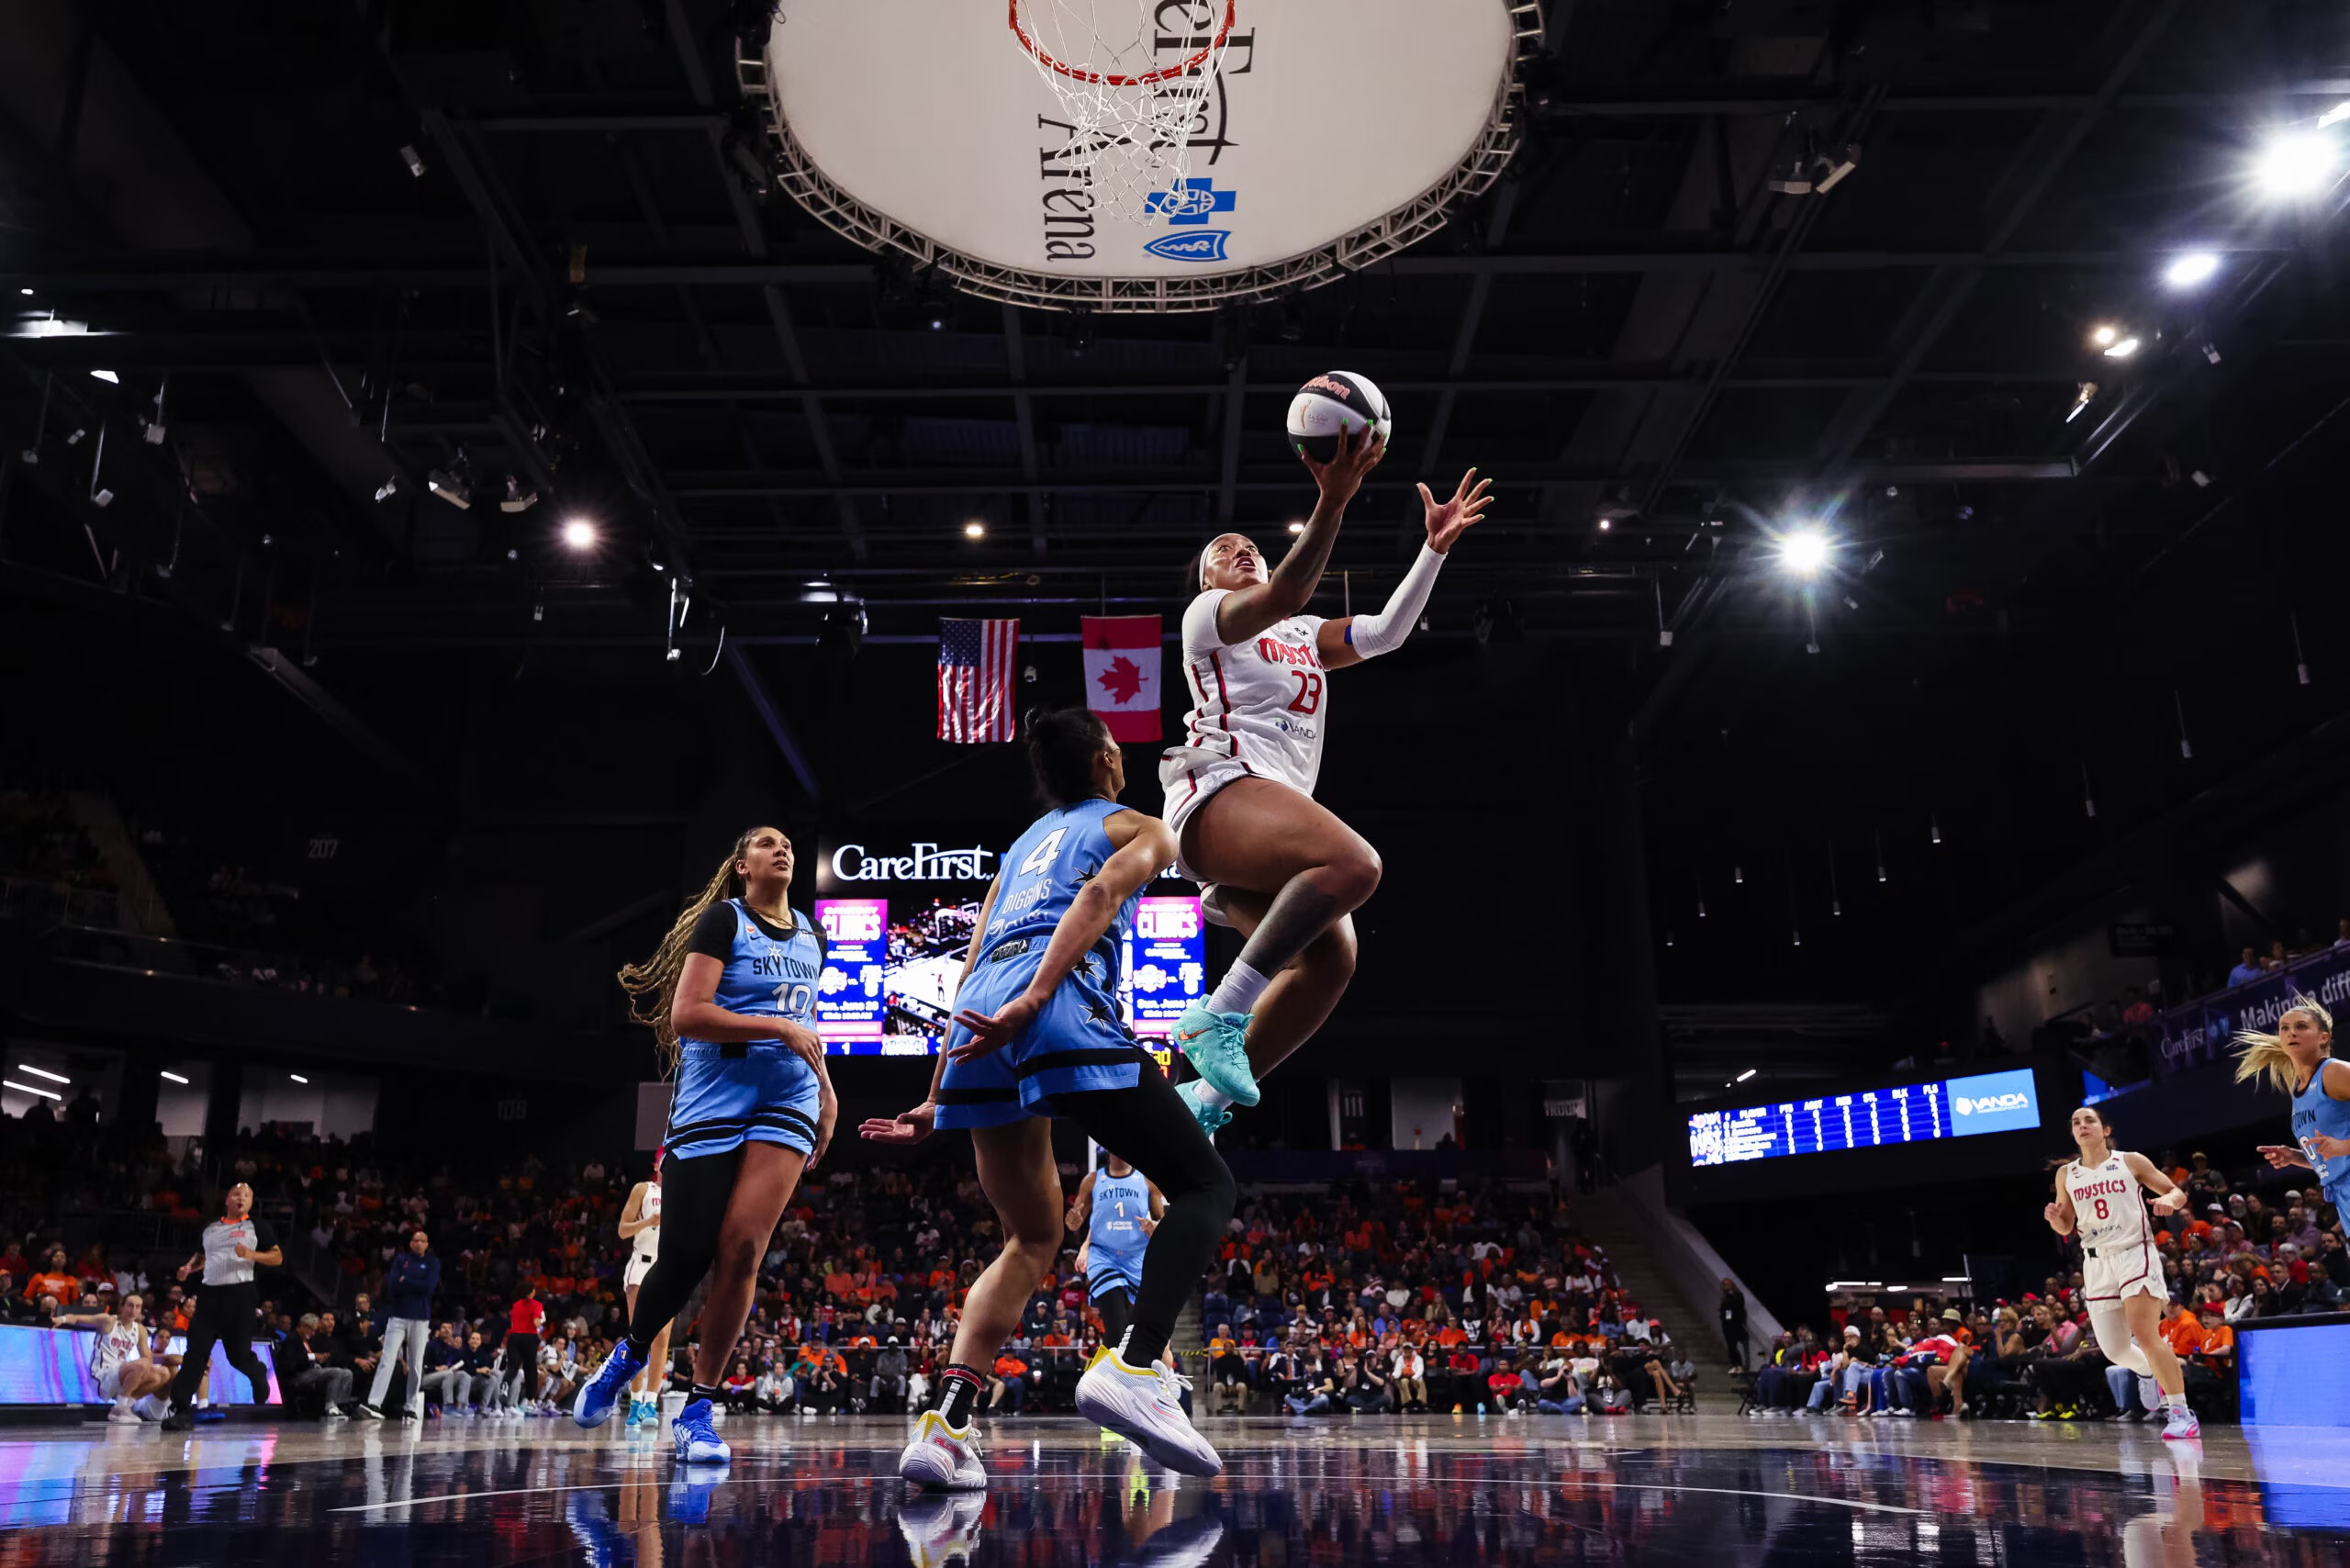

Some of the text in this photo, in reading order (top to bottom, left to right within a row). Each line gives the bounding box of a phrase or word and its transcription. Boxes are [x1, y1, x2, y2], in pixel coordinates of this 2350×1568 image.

[1038, 114, 1132, 263] Arena
[1288, 670, 1322, 714] 23
[308, 838, 338, 859] 207
[1018, 827, 1069, 877] 4
[1002, 878, 1053, 914] DIGGINS
[753, 956, 818, 980] SKYTOWN
[772, 982, 811, 1014] 10
[1971, 1092, 2029, 1110] VANDA
[1099, 1188, 1140, 1202] SKYTOWN
[1113, 1201, 1125, 1218] 1
[2094, 1198, 2109, 1220] 8
